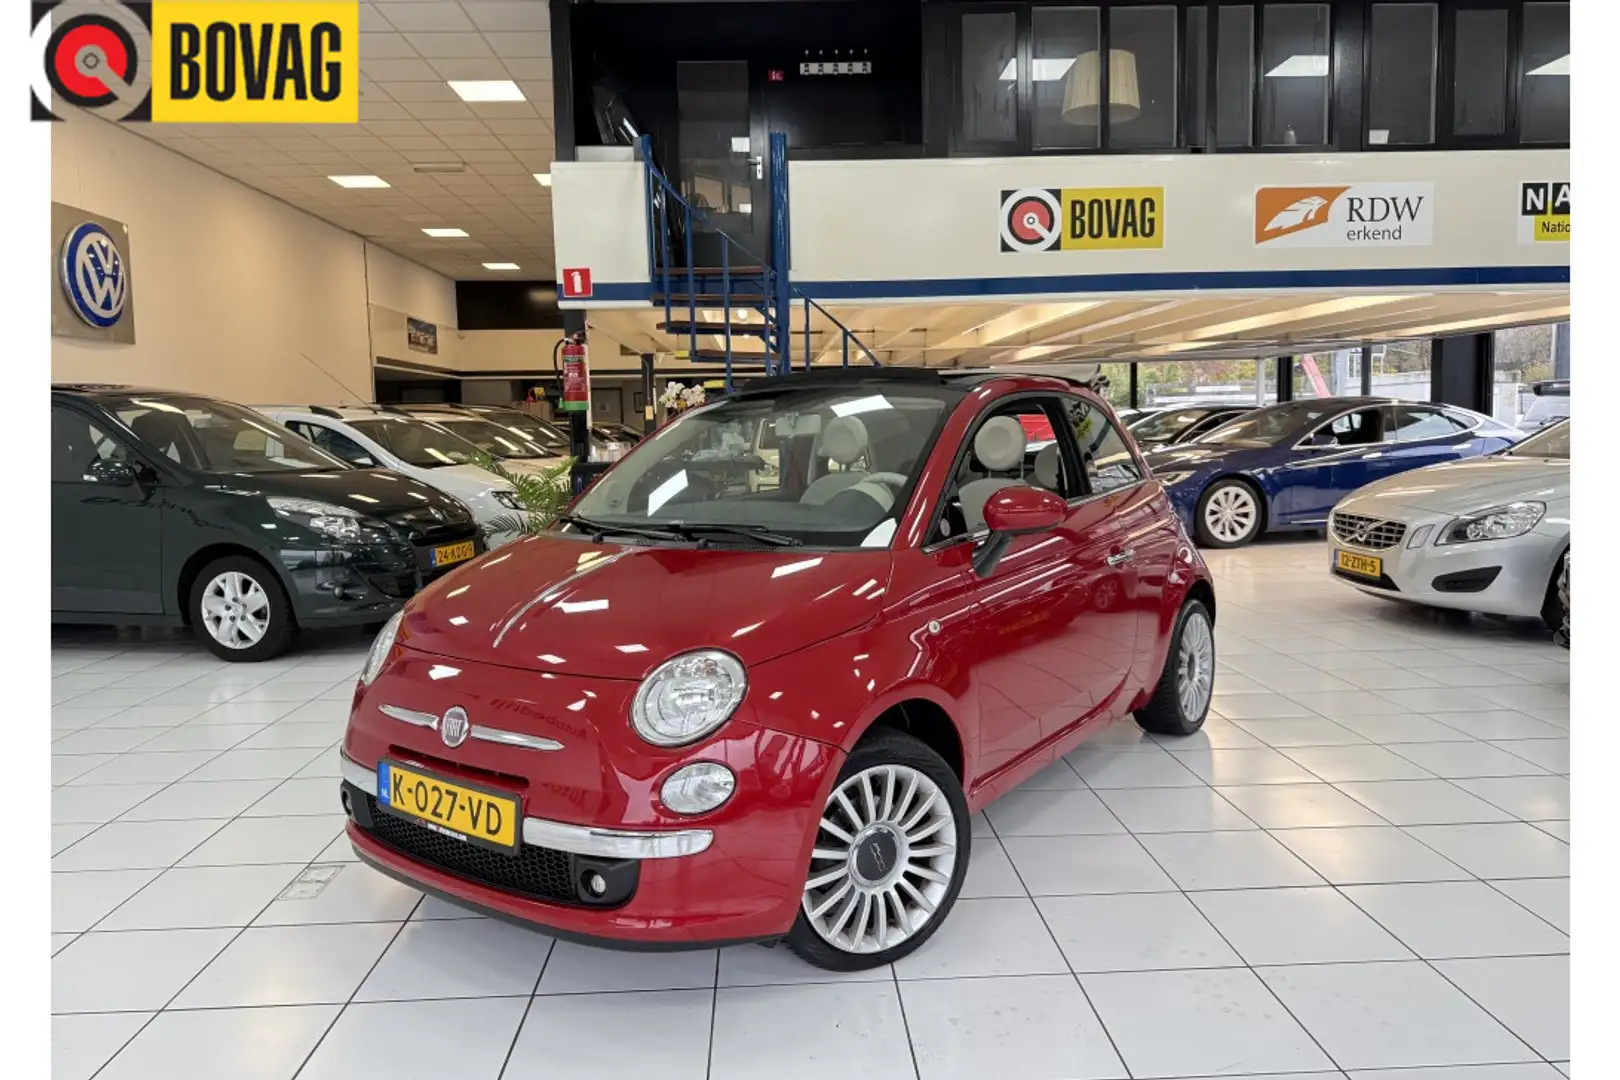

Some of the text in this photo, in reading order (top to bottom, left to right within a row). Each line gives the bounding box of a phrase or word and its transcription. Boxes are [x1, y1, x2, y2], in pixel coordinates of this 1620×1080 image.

[1070, 197, 1156, 239] BOVAG
[1346, 196, 1424, 223] RDW
[1347, 225, 1402, 241] erkend
[393, 772, 502, 836] K-027-VD
